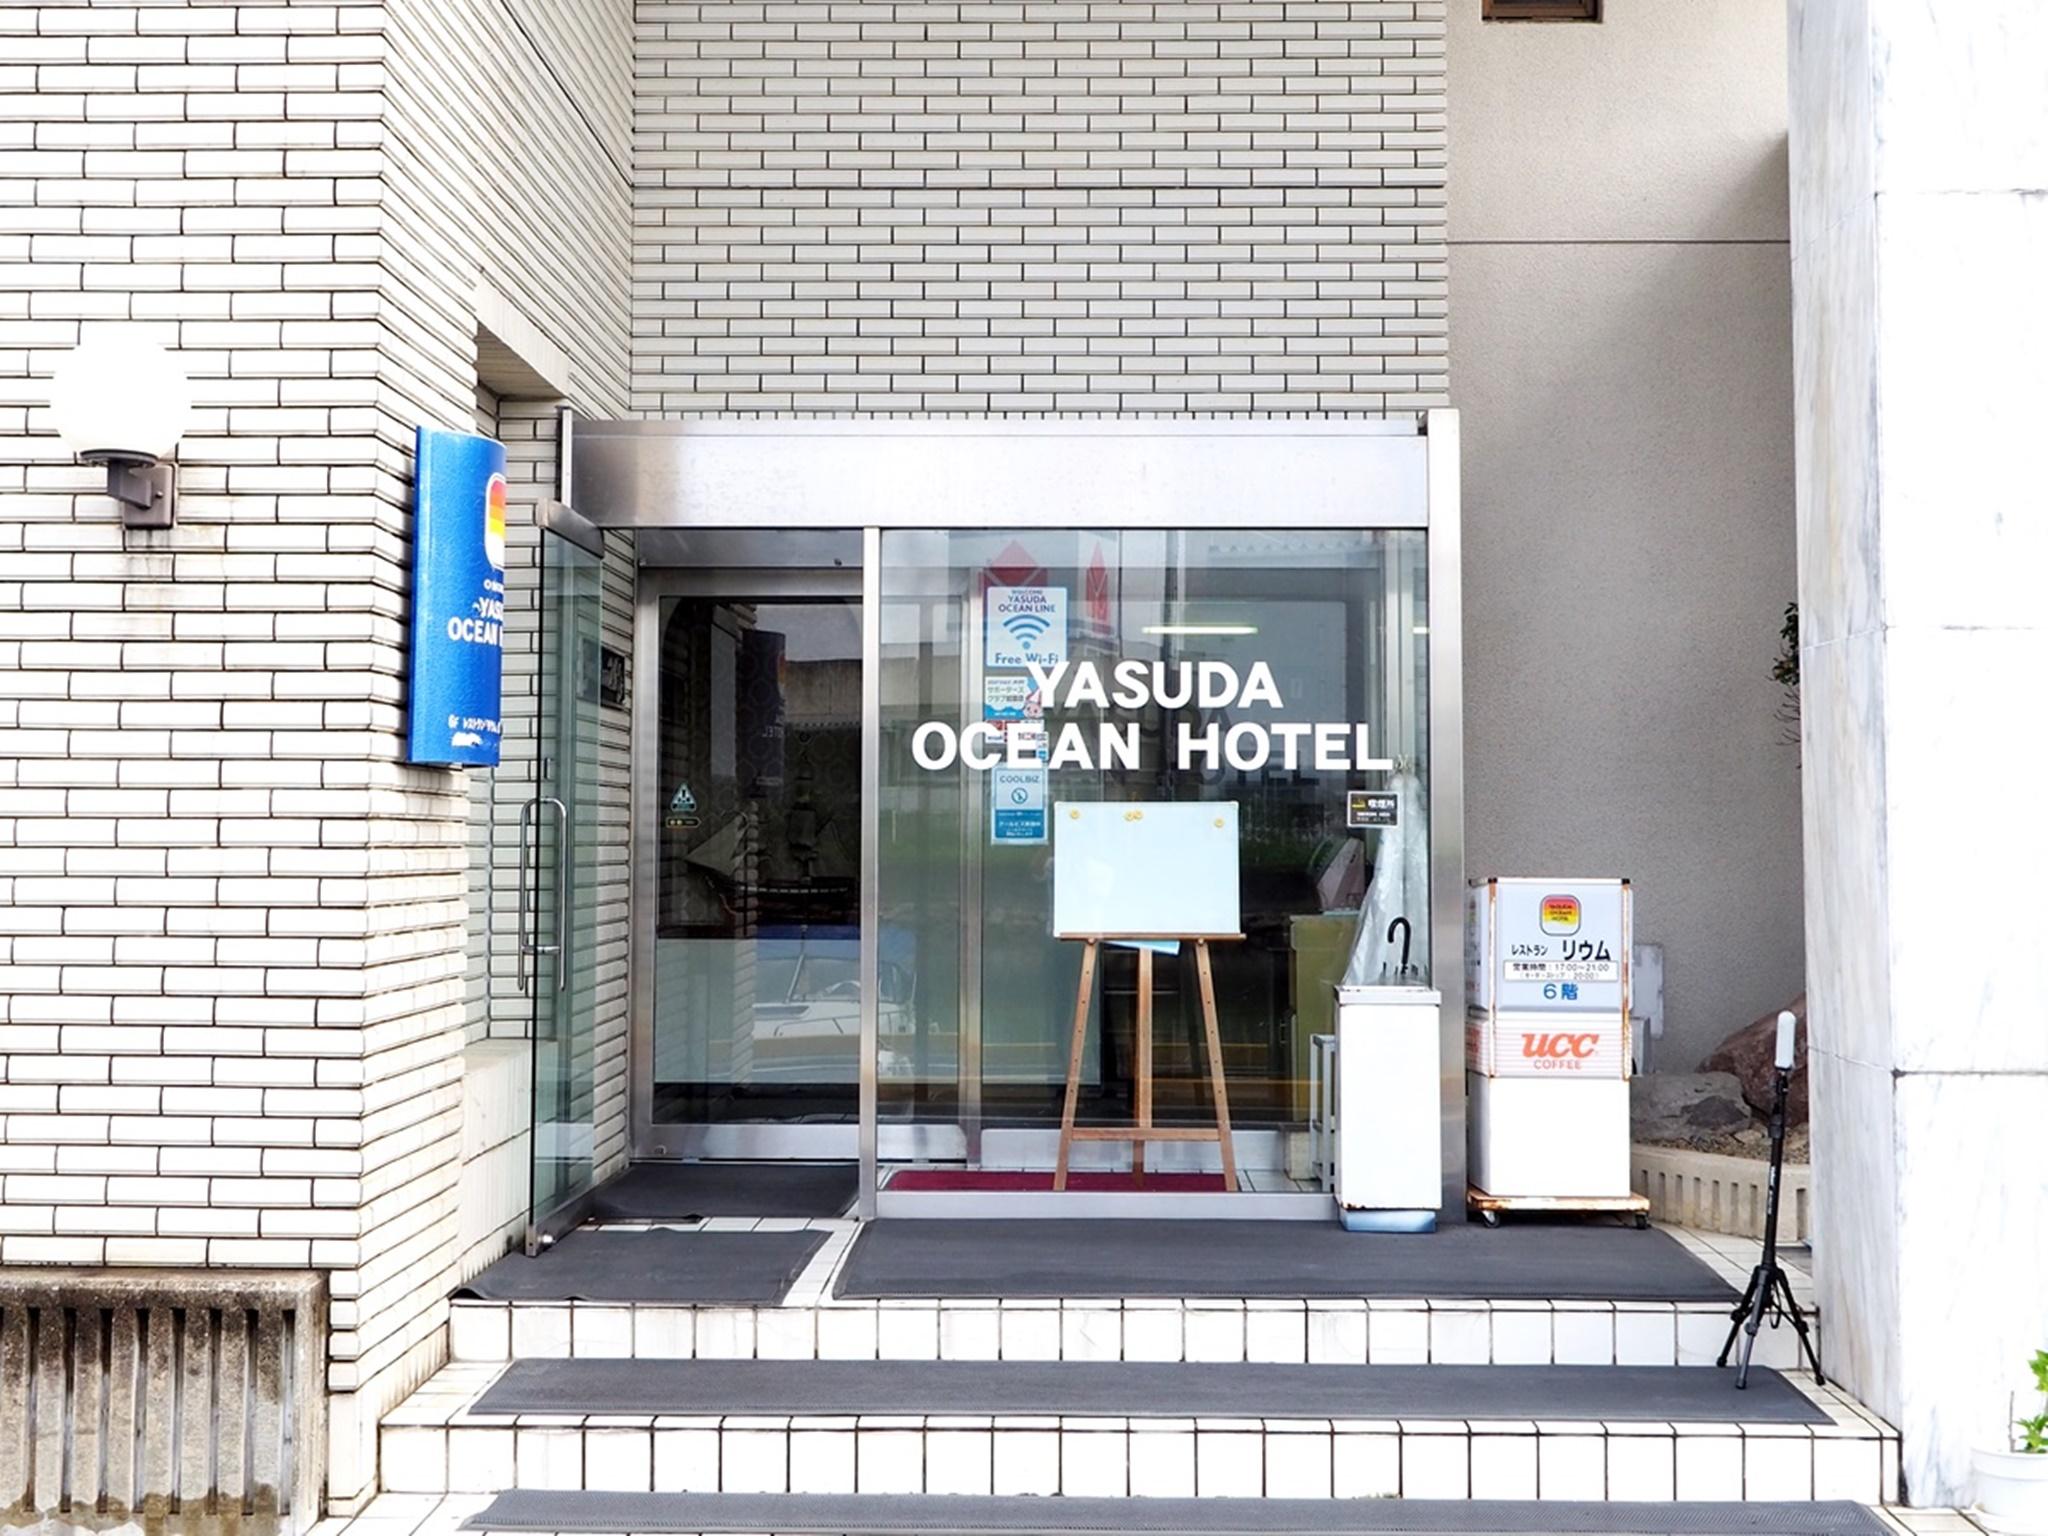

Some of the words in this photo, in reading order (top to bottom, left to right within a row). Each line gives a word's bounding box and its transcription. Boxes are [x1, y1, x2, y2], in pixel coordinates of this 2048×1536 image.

[1008, 595, 1047, 604] YASUDA
[479, 596, 503, 622] YAS
[998, 604, 1033, 613] OCEAN
[1035, 604, 1056, 613] LINE
[995, 652, 1022, 664] Free
[1025, 652, 1059, 665] Wi-Fi
[1026, 661, 1284, 709] YASUDA
[911, 721, 1140, 770] OCEAN
[1178, 722, 1393, 770] HOTEL
[1511, 944, 1549, 957] レストラン
[1562, 939, 1611, 961] リウム
[1533, 1059, 1582, 1070] COFFEE
